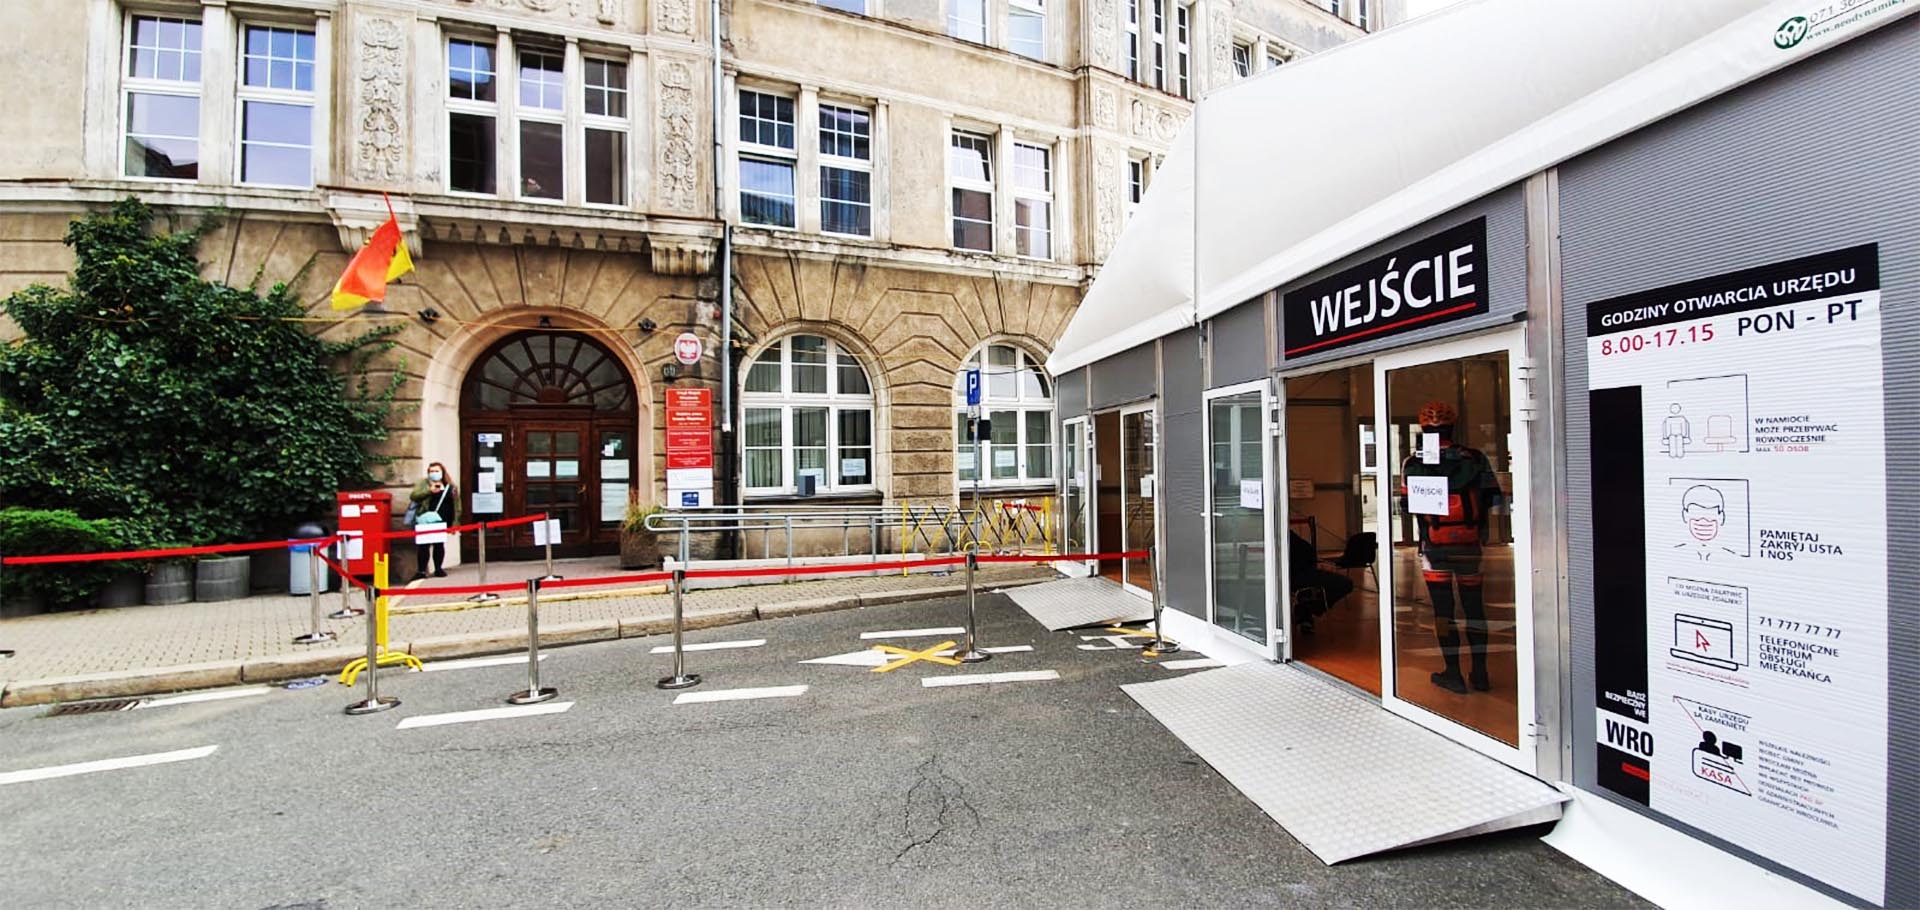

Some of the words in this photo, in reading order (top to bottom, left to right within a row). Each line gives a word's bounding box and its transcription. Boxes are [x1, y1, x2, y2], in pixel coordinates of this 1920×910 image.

[1311, 244, 1475, 336] WEJŚCIE
[1601, 304, 1670, 326] GODZINY
[1674, 286, 1768, 312] OTWARCIA
[1773, 268, 1856, 296] URZĘDU
[1601, 323, 1714, 355] 8.00-17.15
[1738, 310, 1795, 336] PON
[1827, 300, 1862, 323] PT
[969, 373, 978, 395] P
[1766, 415, 1809, 424] NAMIOCIE
[1760, 529, 1819, 542] PAMIĘTAJ
[1760, 539, 1805, 552] ZAKRYJ
[1809, 543, 1843, 555] USTA
[1768, 550, 1793, 561] NOS
[1760, 616, 1772, 627] 71
[1778, 619, 1800, 631] 777
[1805, 623, 1820, 635] 77
[1826, 627, 1841, 639] 77
[1759, 643, 1812, 661] CENTRUM
[1760, 634, 1840, 657] TELEFONICZNE
[1759, 652, 1806, 668] OBSŁUGI
[1760, 661, 1832, 683] MIESZKAŃCA
[1605, 718, 1654, 757] WRO
[1701, 766, 1733, 785] KASA
